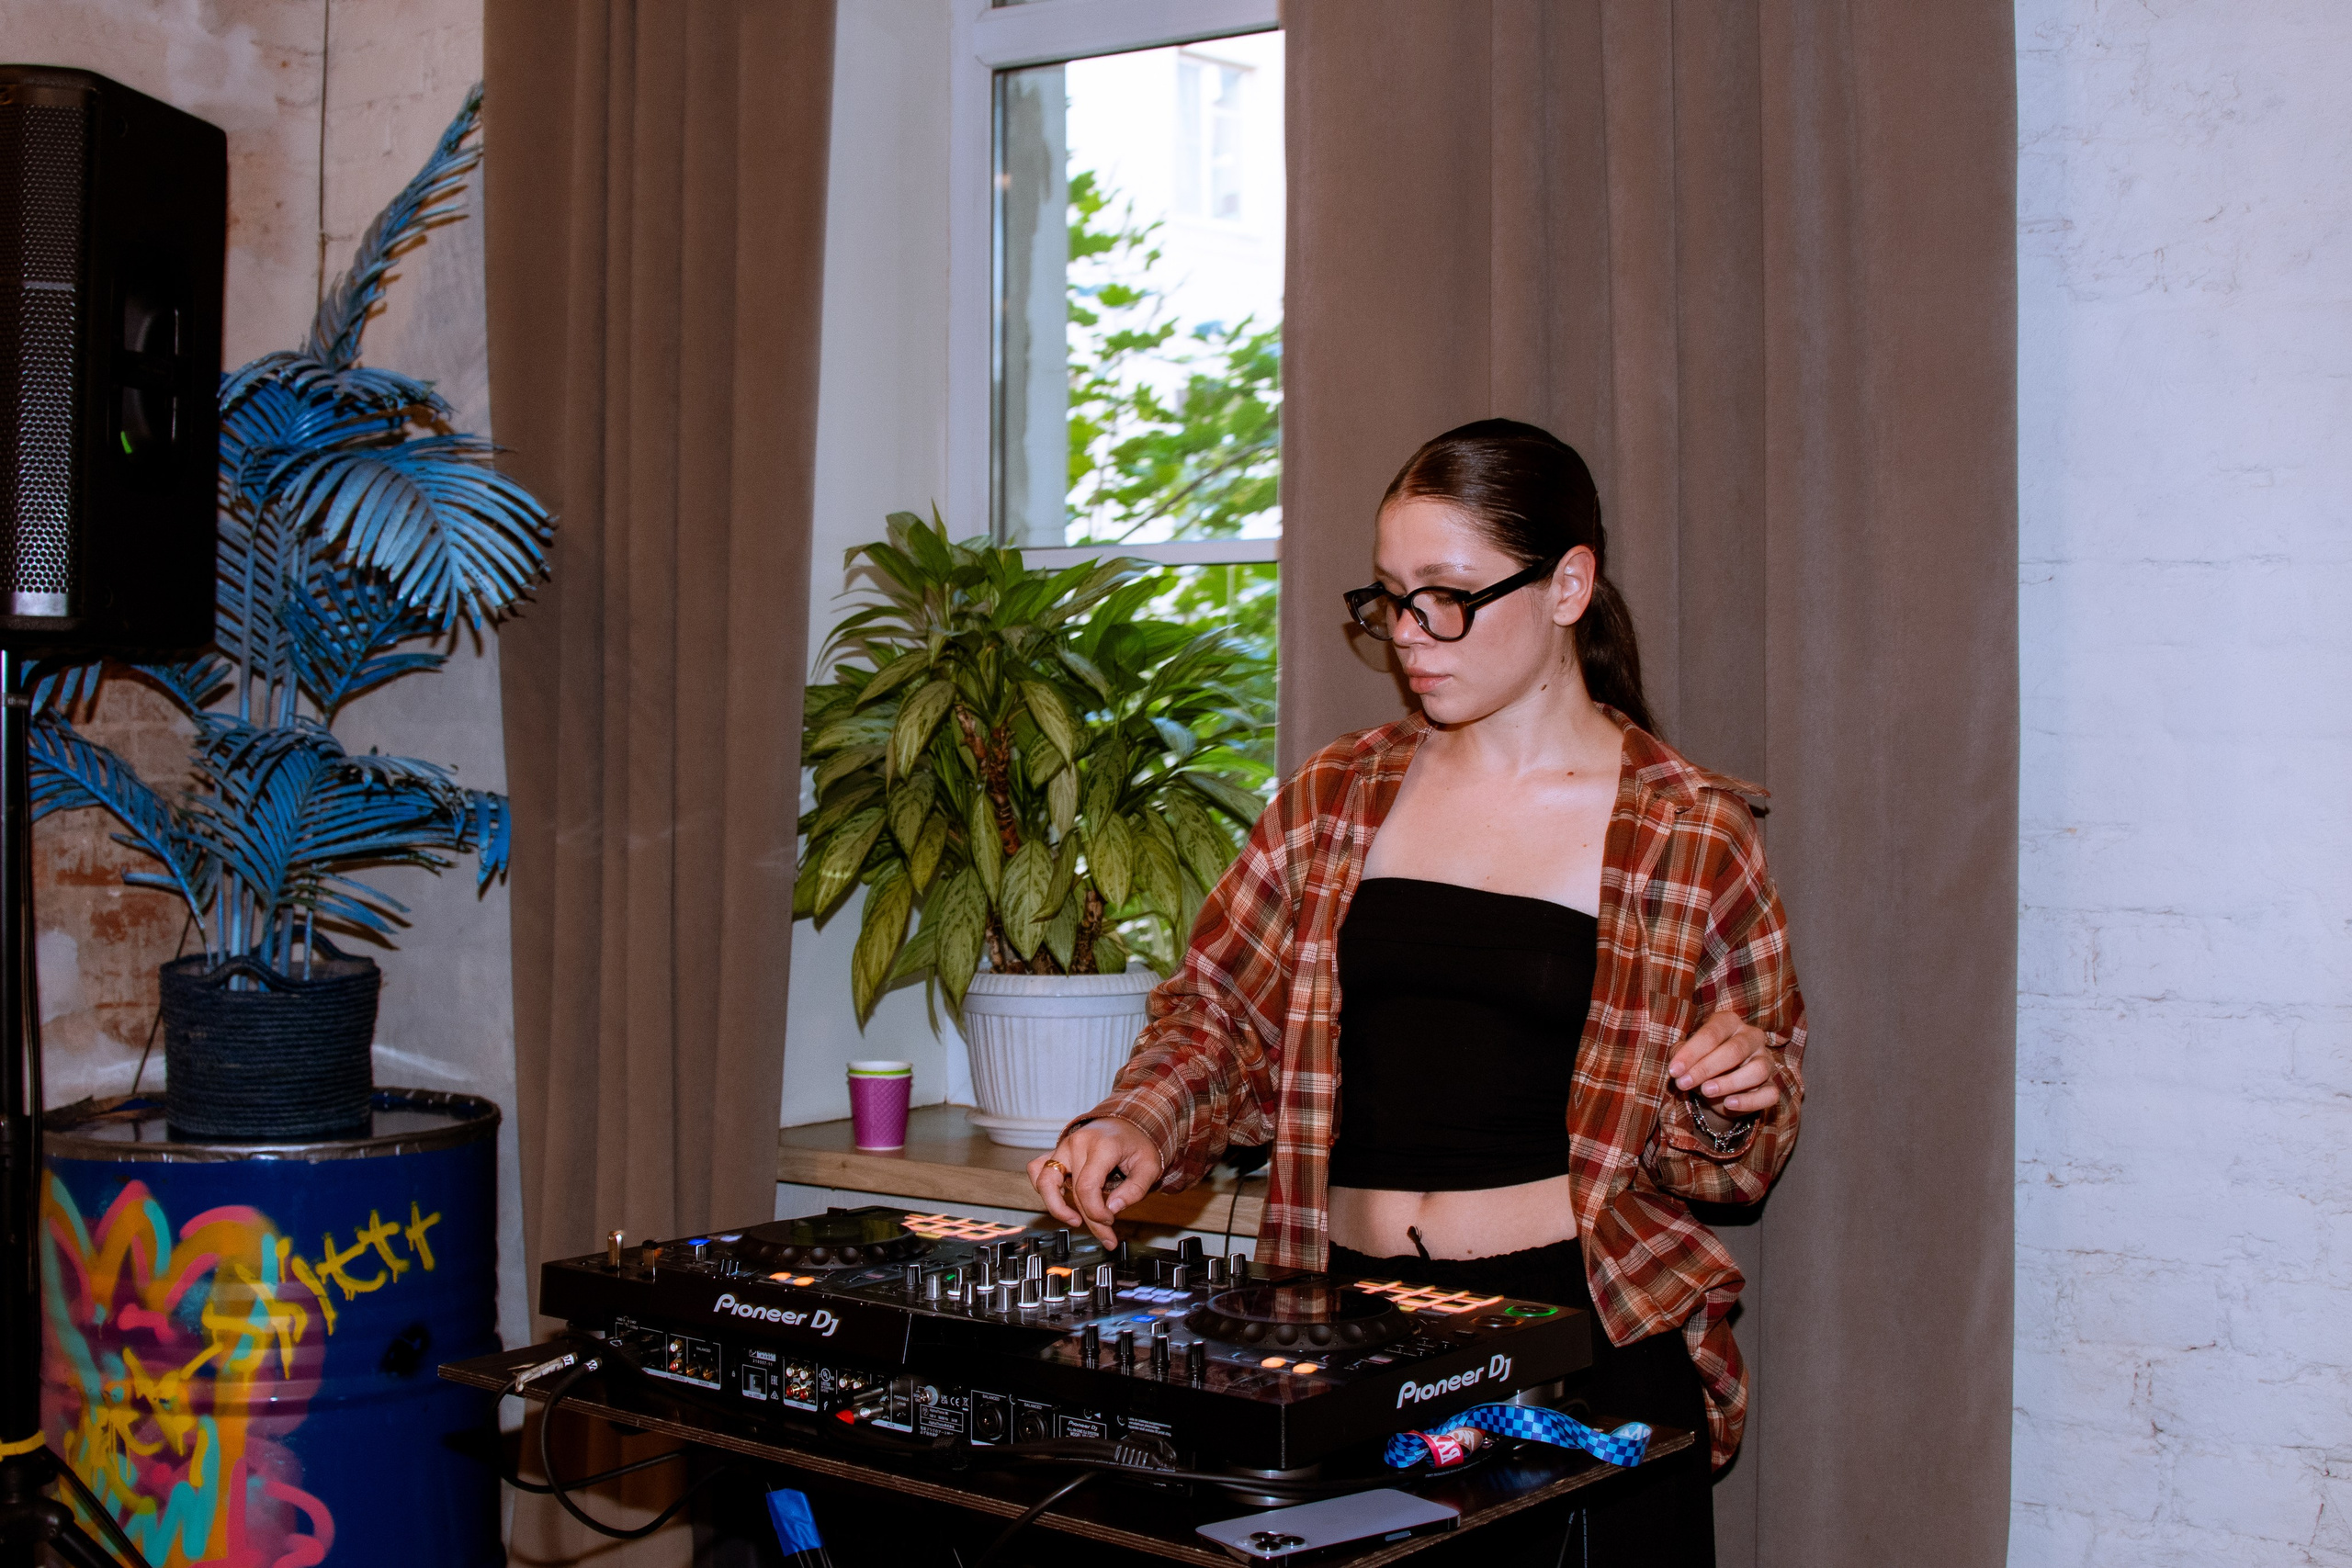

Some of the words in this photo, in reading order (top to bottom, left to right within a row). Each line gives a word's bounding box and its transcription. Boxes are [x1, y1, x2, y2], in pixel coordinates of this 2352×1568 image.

[713, 1293, 808, 1325] Pioneer
[810, 1309, 840, 1337] DJ
[1396, 1366, 1485, 1409] Pioneer
[1487, 1354, 1512, 1382] DJ
[950, 1396, 960, 1407] CE
[981, 1393, 1001, 1402] BALANCED
[1023, 1402, 1043, 1410] BALANCED
[1068, 1419, 1091, 1429] Pioneer
